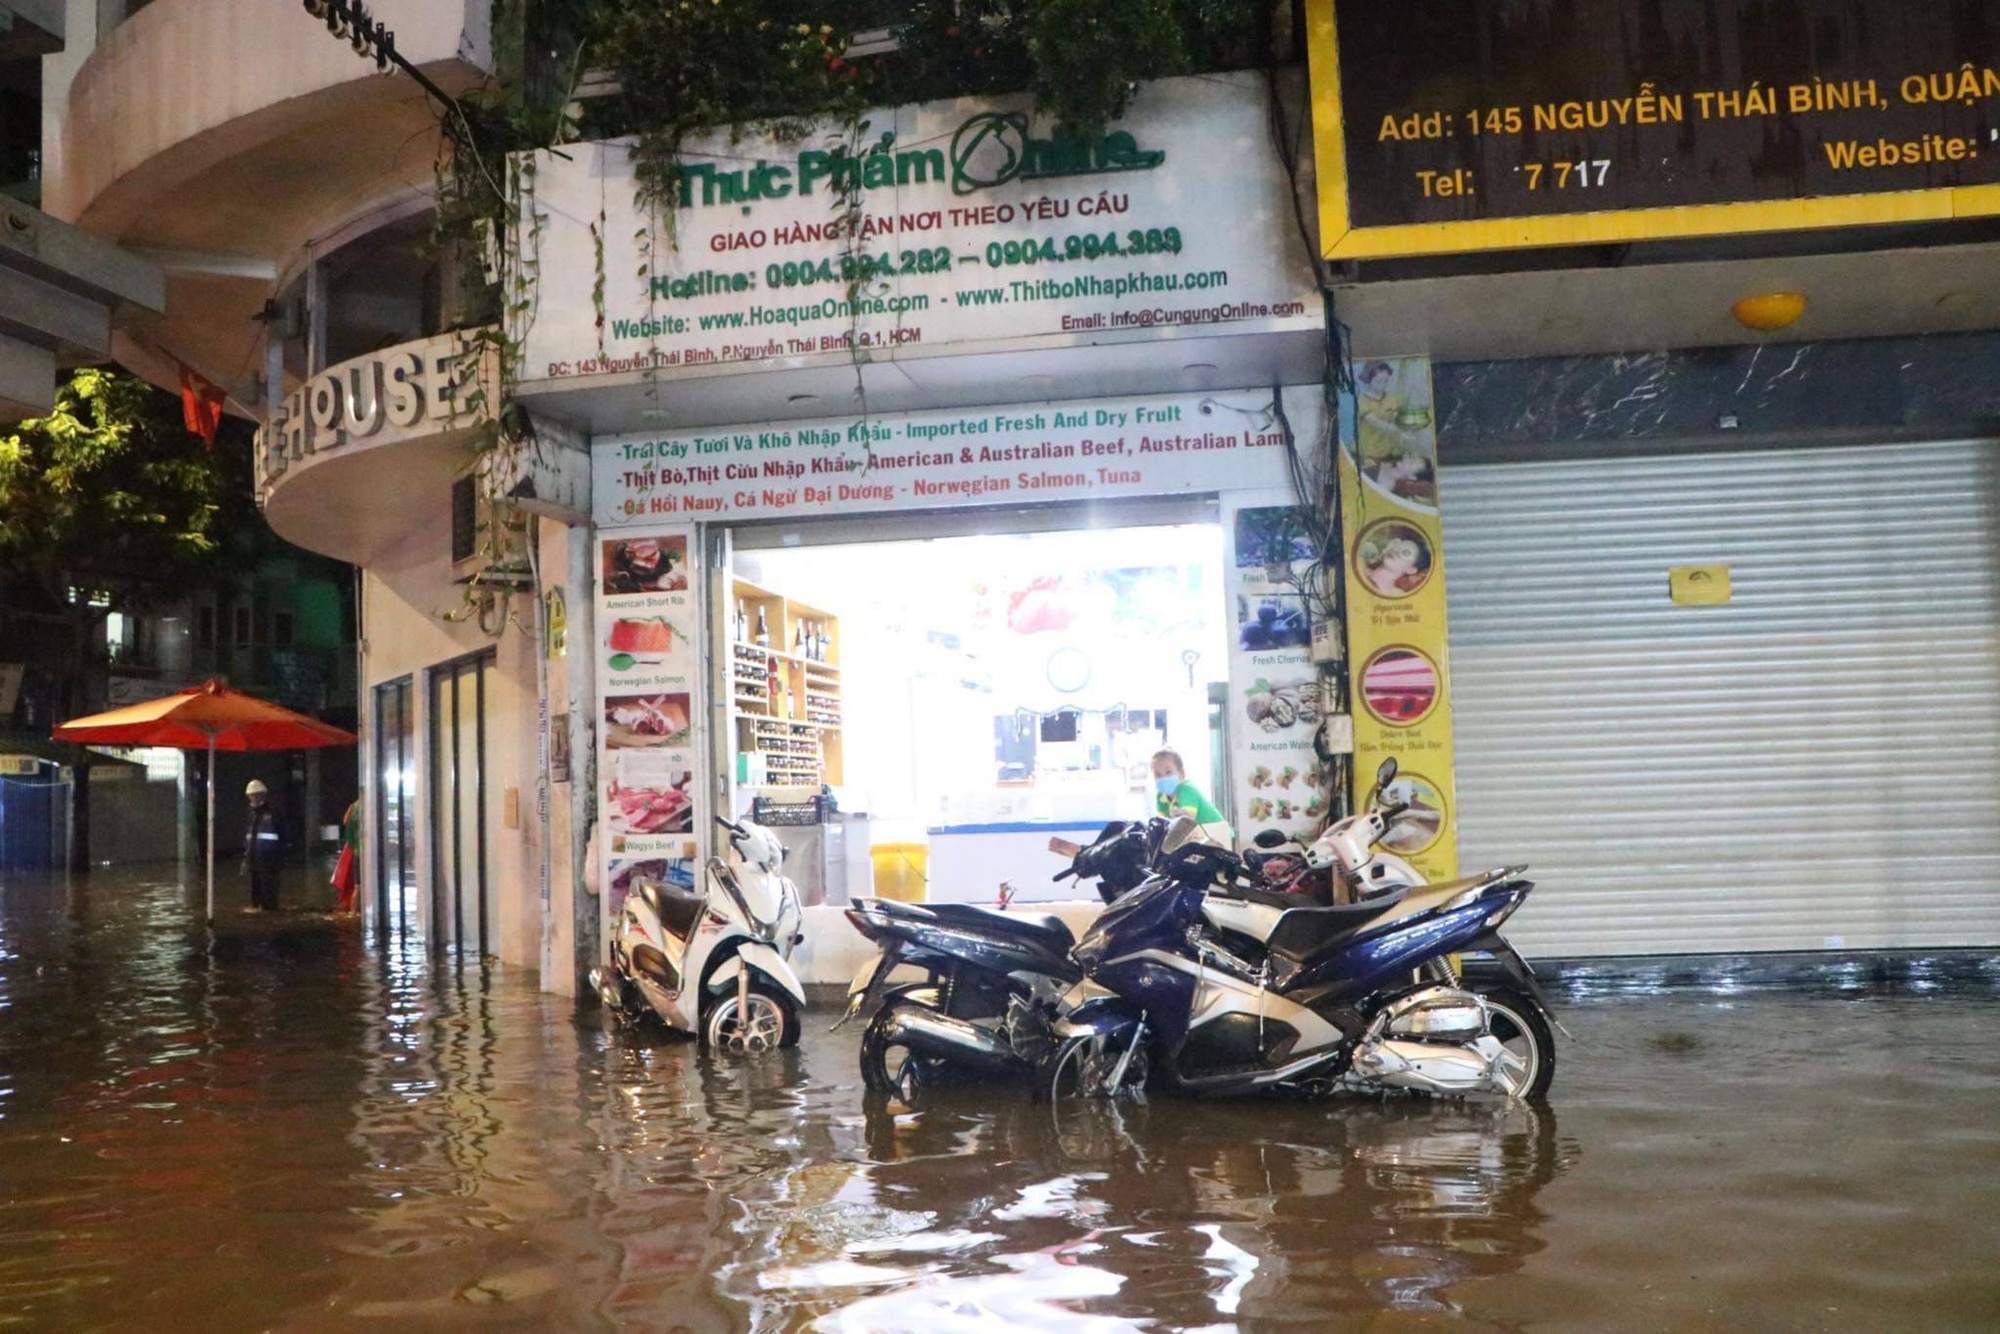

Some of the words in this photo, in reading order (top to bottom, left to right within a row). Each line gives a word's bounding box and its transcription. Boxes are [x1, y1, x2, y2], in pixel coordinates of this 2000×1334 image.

[1378, 110, 1453, 142] Add:
[1466, 106, 1523, 136] 145
[1533, 82, 1684, 132] NGUYỄN
[1694, 81, 1776, 120] THÁI
[1789, 76, 1888, 113] BÌNH,
[1824, 133, 1977, 170] Website:
[1416, 168, 1474, 198] Tel:
[710, 230, 766, 251] GIAO
[900, 211, 942, 232] NƠI
[949, 204, 1015, 227] THEO
[1020, 196, 1071, 221] YÊU
[651, 269, 757, 301] Hotline:
[612, 314, 690, 340] Website:
[956, 269, 1228, 306] www.ThitboNhapkhau.com
[1061, 313, 1106, 331] Email:
[1110, 302, 1305, 329] info@CungungOnline.com
[576, 359, 597, 373] 143
[889, 328, 921, 344] HCM
[282, 339, 470, 462] HOUSE
[659, 440, 688, 458] Cây
[694, 436, 728, 454] Tươi
[733, 434, 753, 451] Và
[759, 431, 792, 449] Khô
[798, 428, 841, 448] Nhập
[907, 418, 988, 441] Imported
[995, 413, 1046, 432] Fresh
[1053, 410, 1088, 428] And
[1096, 409, 1127, 428] Dry
[1136, 405, 1182, 424] Fruit
[763, 459, 805, 479] Nhập
[868, 450, 953, 470] American
[960, 447, 974, 464] &
[980, 442, 1074, 462] Australian
[1081, 437, 1132, 457] Beef,
[1140, 432, 1237, 453] Australian
[1244, 431, 1288, 447] Lam
[651, 494, 677, 513] Hồi
[734, 491, 756, 508] Cá
[839, 484, 894, 501] Dương
[914, 475, 1010, 496] Norwegian
[1018, 472, 1092, 490] Salmon,
[1097, 467, 1141, 485] Tuna
[606, 599, 645, 609] American
[647, 597, 668, 608] Short
[671, 595, 685, 605] Rib
[1253, 655, 1276, 665] Fresh
[609, 677, 652, 688] Norwegian
[655, 675, 685, 685] Salmon
[1250, 740, 1288, 751] American
[625, 841, 654, 851] Wagyu
[656, 840, 675, 850] Beef
